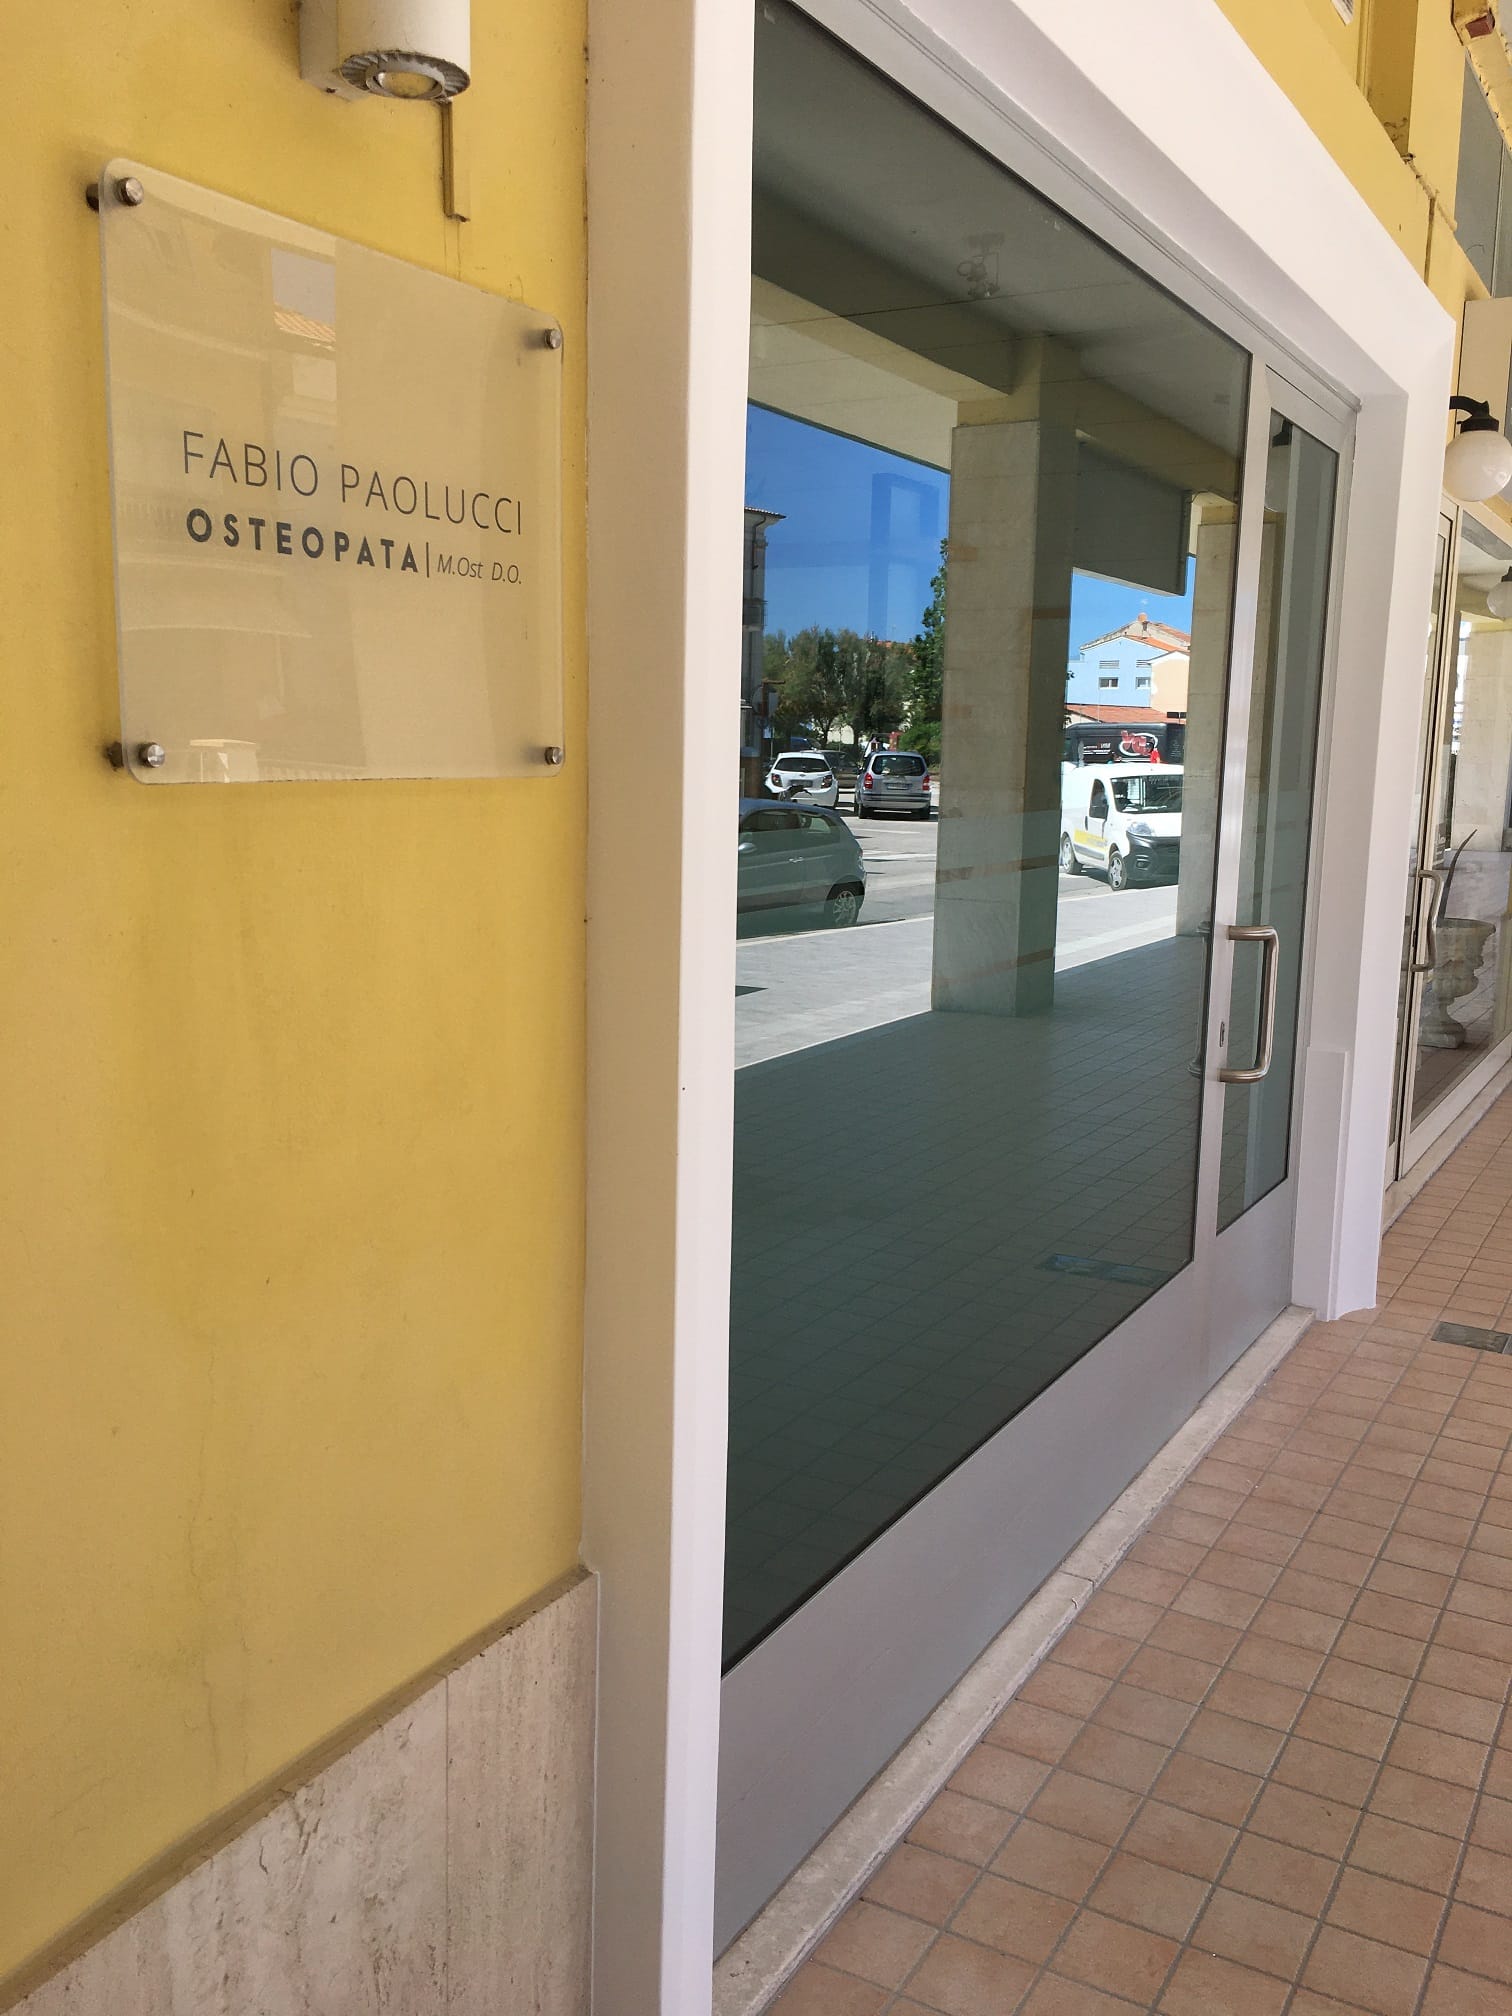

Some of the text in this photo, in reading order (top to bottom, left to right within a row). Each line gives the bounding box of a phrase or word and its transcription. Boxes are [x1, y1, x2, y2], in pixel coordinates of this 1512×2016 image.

[183, 430, 522, 536] FABIO PAOLUCCI
[186, 507, 522, 585] OSTEOPATA M.Ost D.O.
